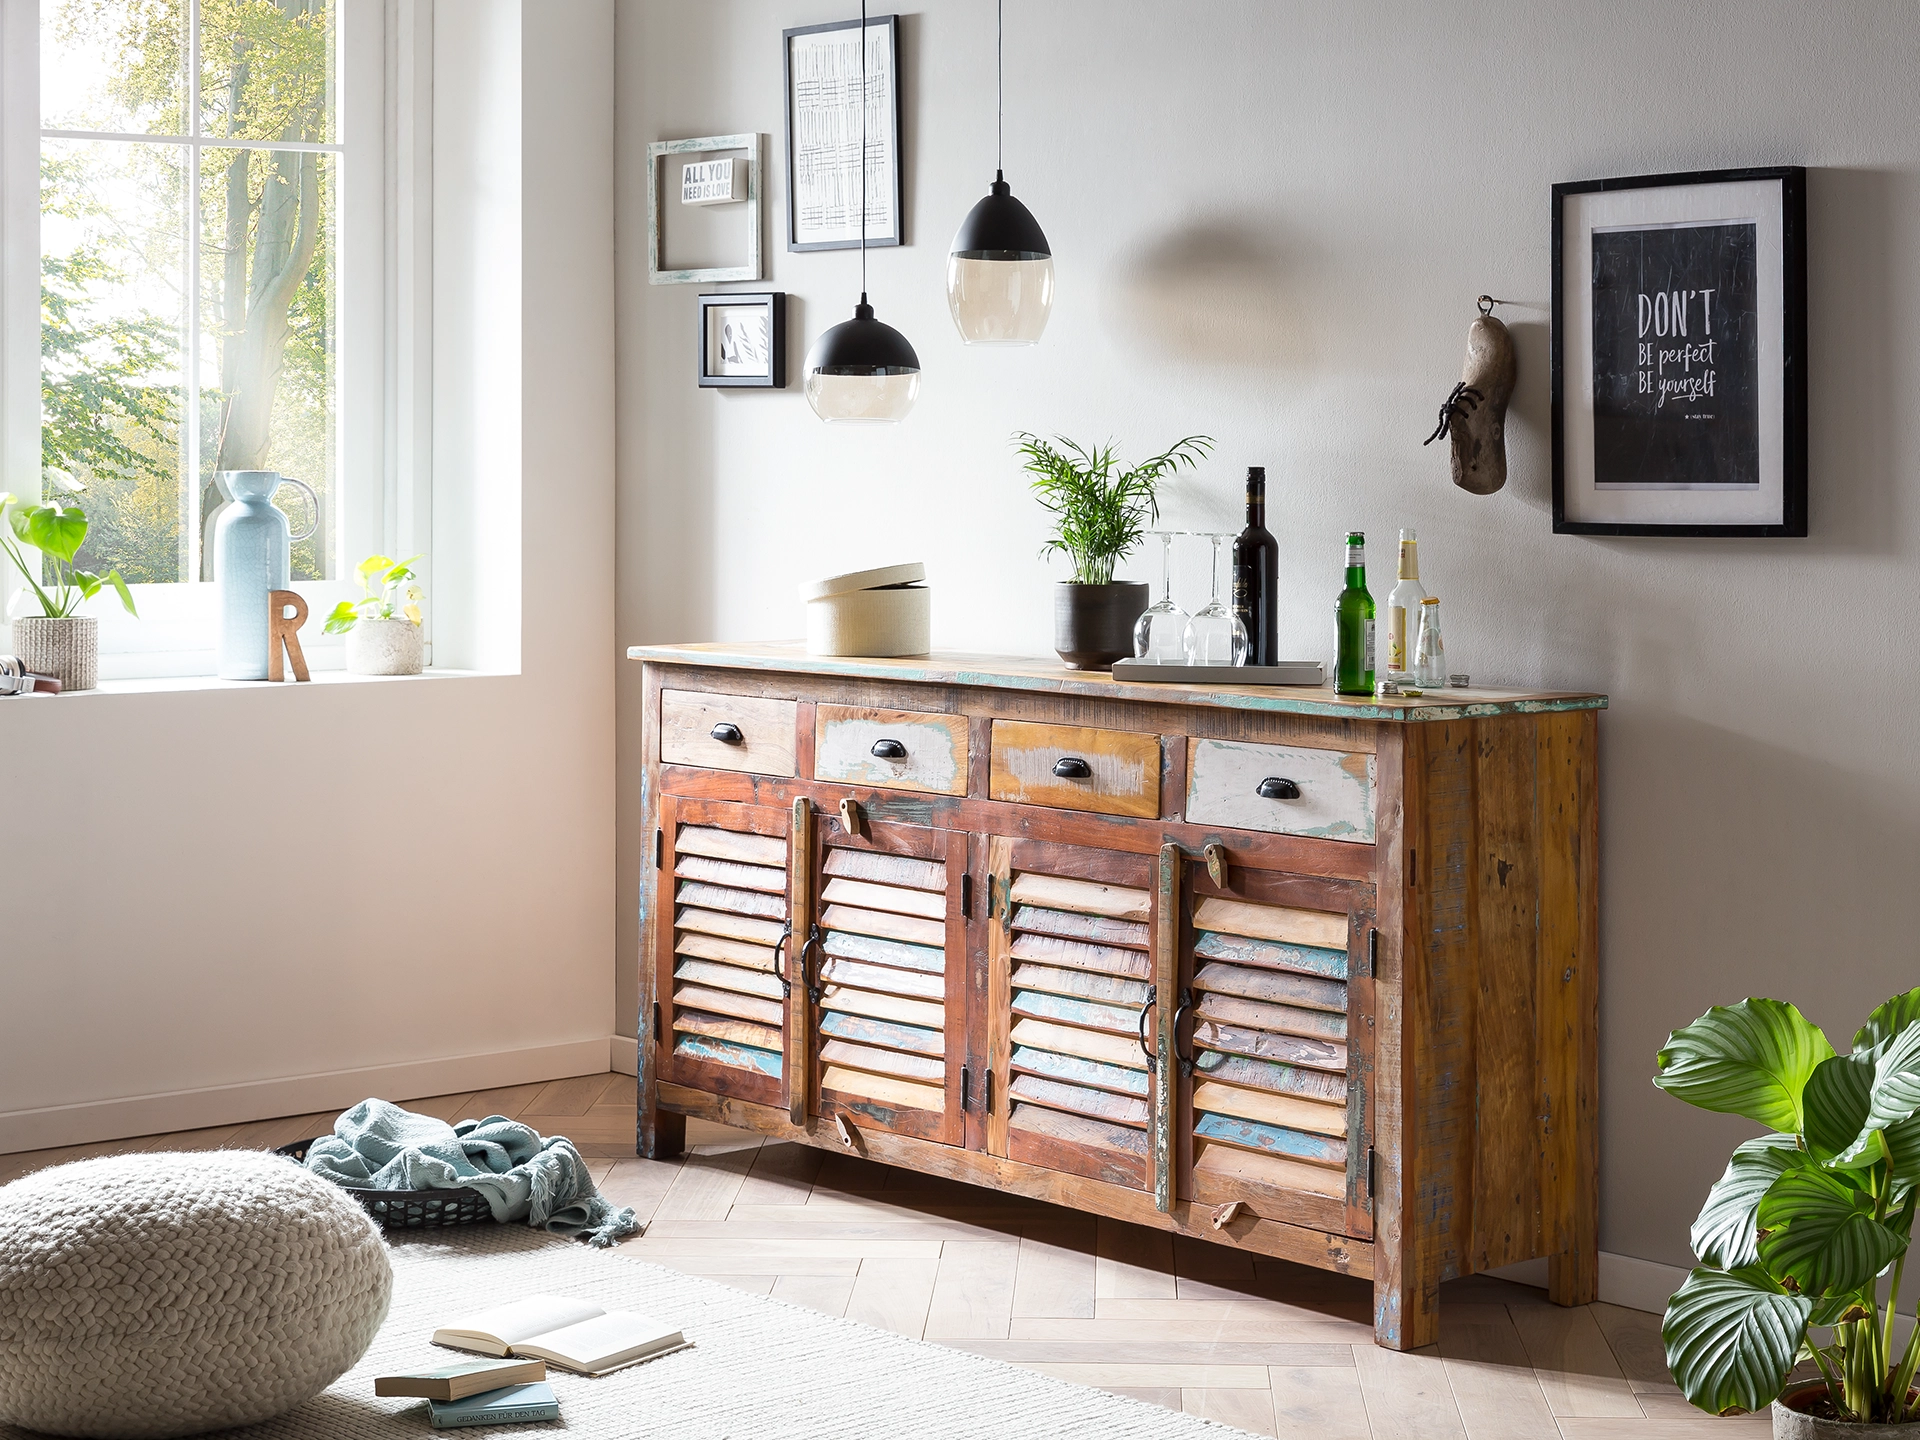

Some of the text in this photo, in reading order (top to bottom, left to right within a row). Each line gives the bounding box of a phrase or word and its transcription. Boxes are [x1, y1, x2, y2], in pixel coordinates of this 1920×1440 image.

[683, 182, 730, 200] NEED IS LOVE
[684, 162, 731, 184] ALL YOU
[1638, 288, 1716, 339] DON'T
[1638, 338, 1717, 375] BE perfect
[1638, 369, 1717, 408] BE yourself
[268, 590, 311, 682] R
[457, 1409, 546, 1423] GEDANKEN FÜR DEN TAG
